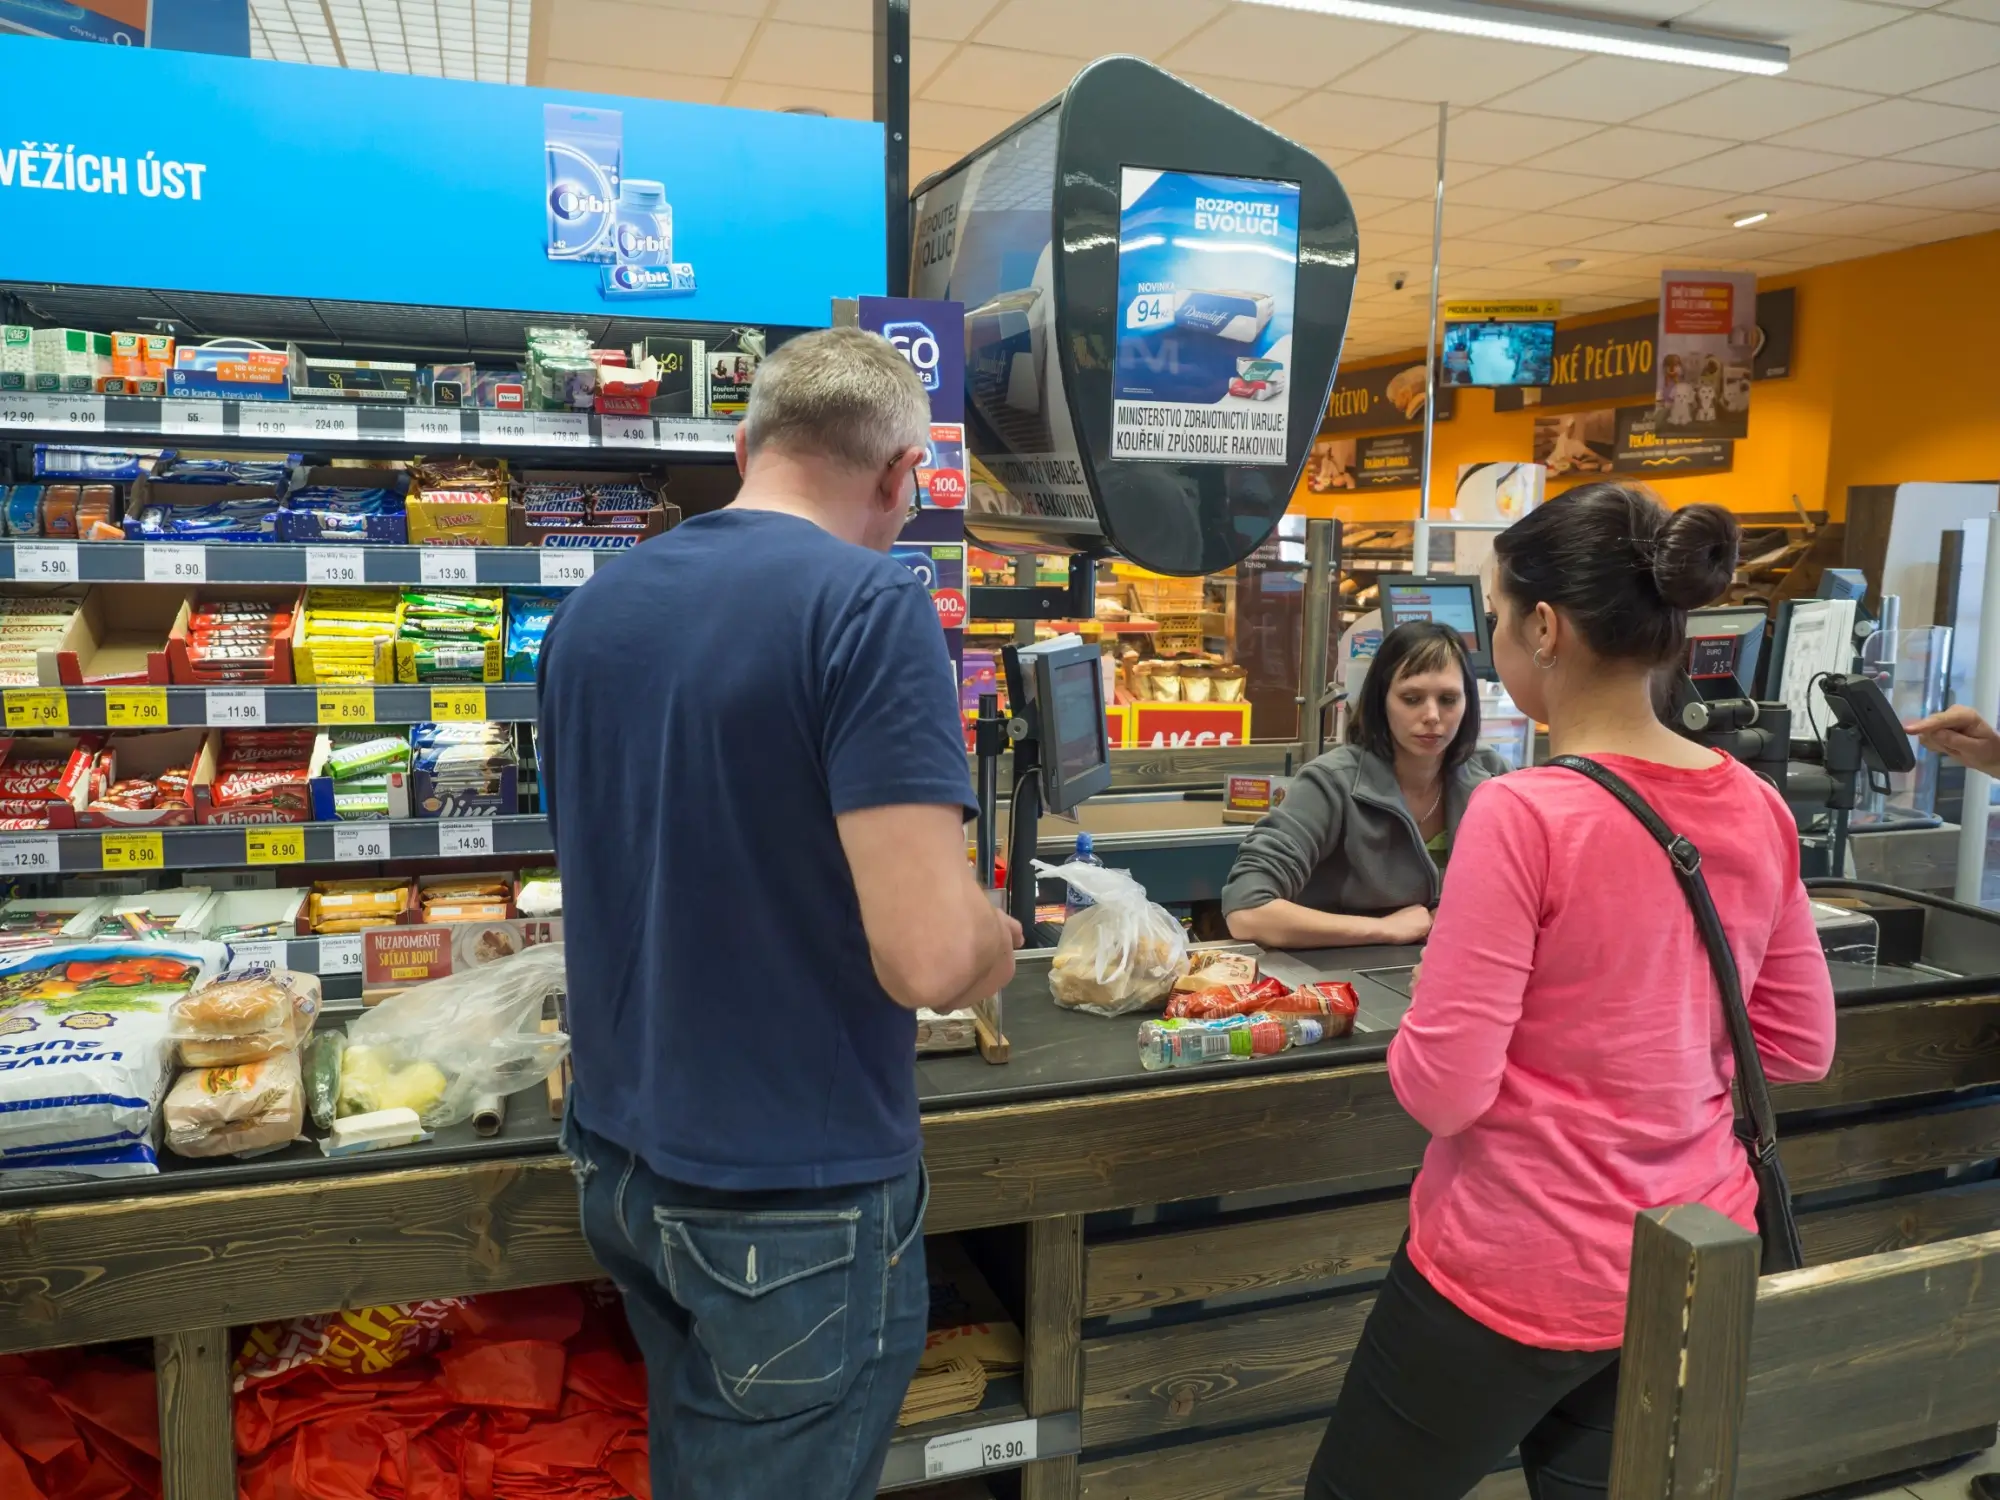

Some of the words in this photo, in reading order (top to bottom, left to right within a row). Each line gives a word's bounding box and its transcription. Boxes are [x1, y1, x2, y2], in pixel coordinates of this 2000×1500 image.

[137, 150, 207, 201] ÚST
[1195, 196, 1280, 218] ROZPOUTEJ
[1193, 212, 1280, 237] EVOLUCI
[617, 224, 671, 259] Orbit
[614, 264, 670, 290] Orbit
[1137, 299, 1161, 322] 94
[1183, 304, 1230, 326] Davidoff
[1584, 337, 1654, 381] PEČIVO
[173, 387, 190, 398] GO
[500, 393, 519, 401] West
[1328, 387, 1370, 418] PEČIVO
[3, 410, 35, 423] 12.90
[69, 411, 96, 423] 9.00
[1117, 405, 1182, 428] MINISTERSTVO
[1183, 408, 1251, 432] ZDRAVOTNICTVÍ
[1251, 412, 1285, 432] VARUJE:
[256, 421, 286, 434] 19.90
[315, 419, 345, 430] 224.00
[420, 423, 449, 434] 113.00
[497, 425, 525, 437] 116.00
[552, 431, 580, 442] 178.00
[623, 429, 645, 440] 4.90
[1116, 428, 1165, 452] KOUŘENÍ
[1167, 430, 1229, 454] ZPŮSOBUJE
[1231, 436, 1285, 457] RAKOVINU
[1035, 492, 1095, 520] RAKOVINU
[41, 560, 67, 573] 5.90
[175, 563, 199, 575] 8.90
[1244, 561, 1267, 570] Tchibo
[325, 568, 355, 580] 13.90
[439, 568, 467, 579] 13.90
[558, 567, 585, 579] 13.90
[1396, 613, 1429, 623] PENNY
[1706, 648, 1722, 656] EURO
[32, 706, 59, 719] 7.90
[132, 705, 159, 718] 7.90
[227, 706, 257, 717] 11.90
[342, 705, 367, 717] 8.90
[454, 703, 478, 715] 8.90
[5, 778, 51, 794] KitKat
[220, 772, 297, 797] Miňonky
[207, 811, 296, 825] Miňonky
[457, 836, 486, 849] 14.90
[129, 848, 155, 862] 8.90
[271, 843, 296, 856] 8.90
[357, 844, 381, 856] 9.90
[14, 853, 46, 866] 12.90
[374, 931, 442, 950] NEZAPOMEŇTE
